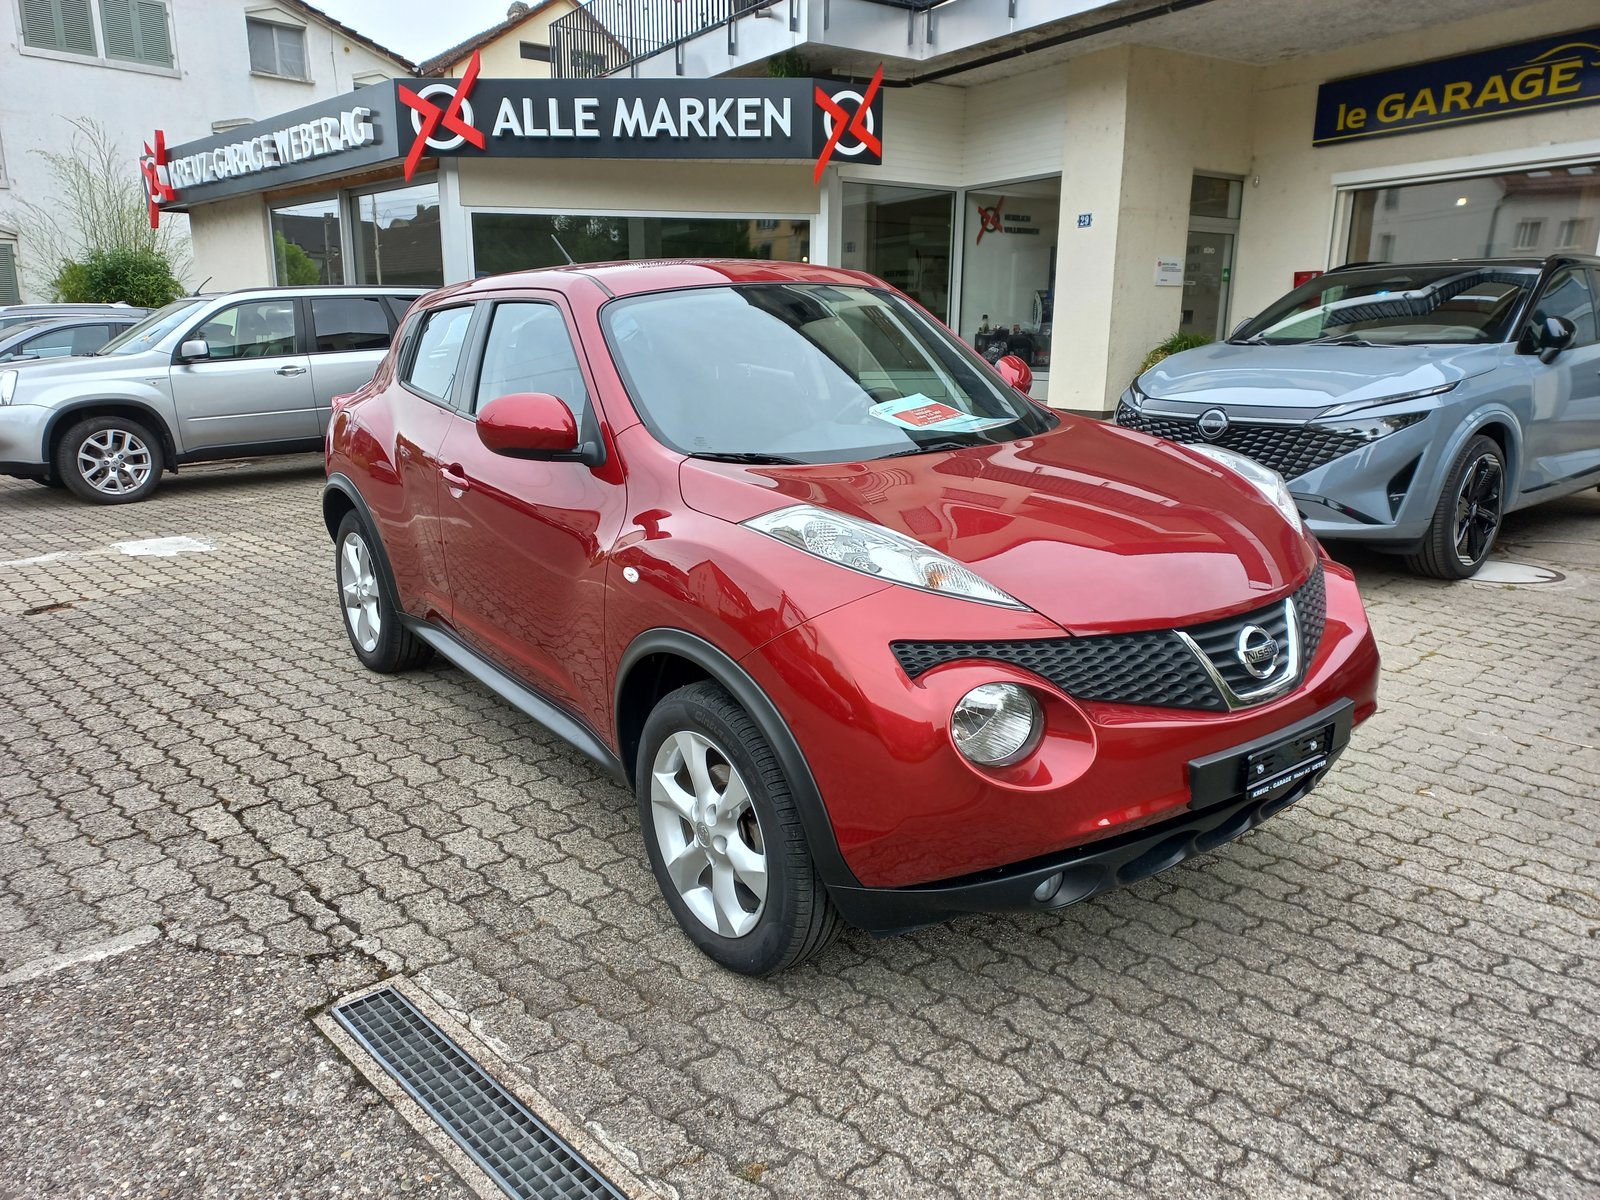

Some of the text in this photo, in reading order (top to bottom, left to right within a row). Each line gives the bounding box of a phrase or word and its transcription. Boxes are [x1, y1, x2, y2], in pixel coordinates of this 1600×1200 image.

[491, 97, 792, 138] ALLE MARKEN
[1336, 59, 1584, 131] le GARAGE
[167, 106, 375, 190] KREUZ-GARAGE WEBER AG
[1079, 214, 1091, 226] 29
